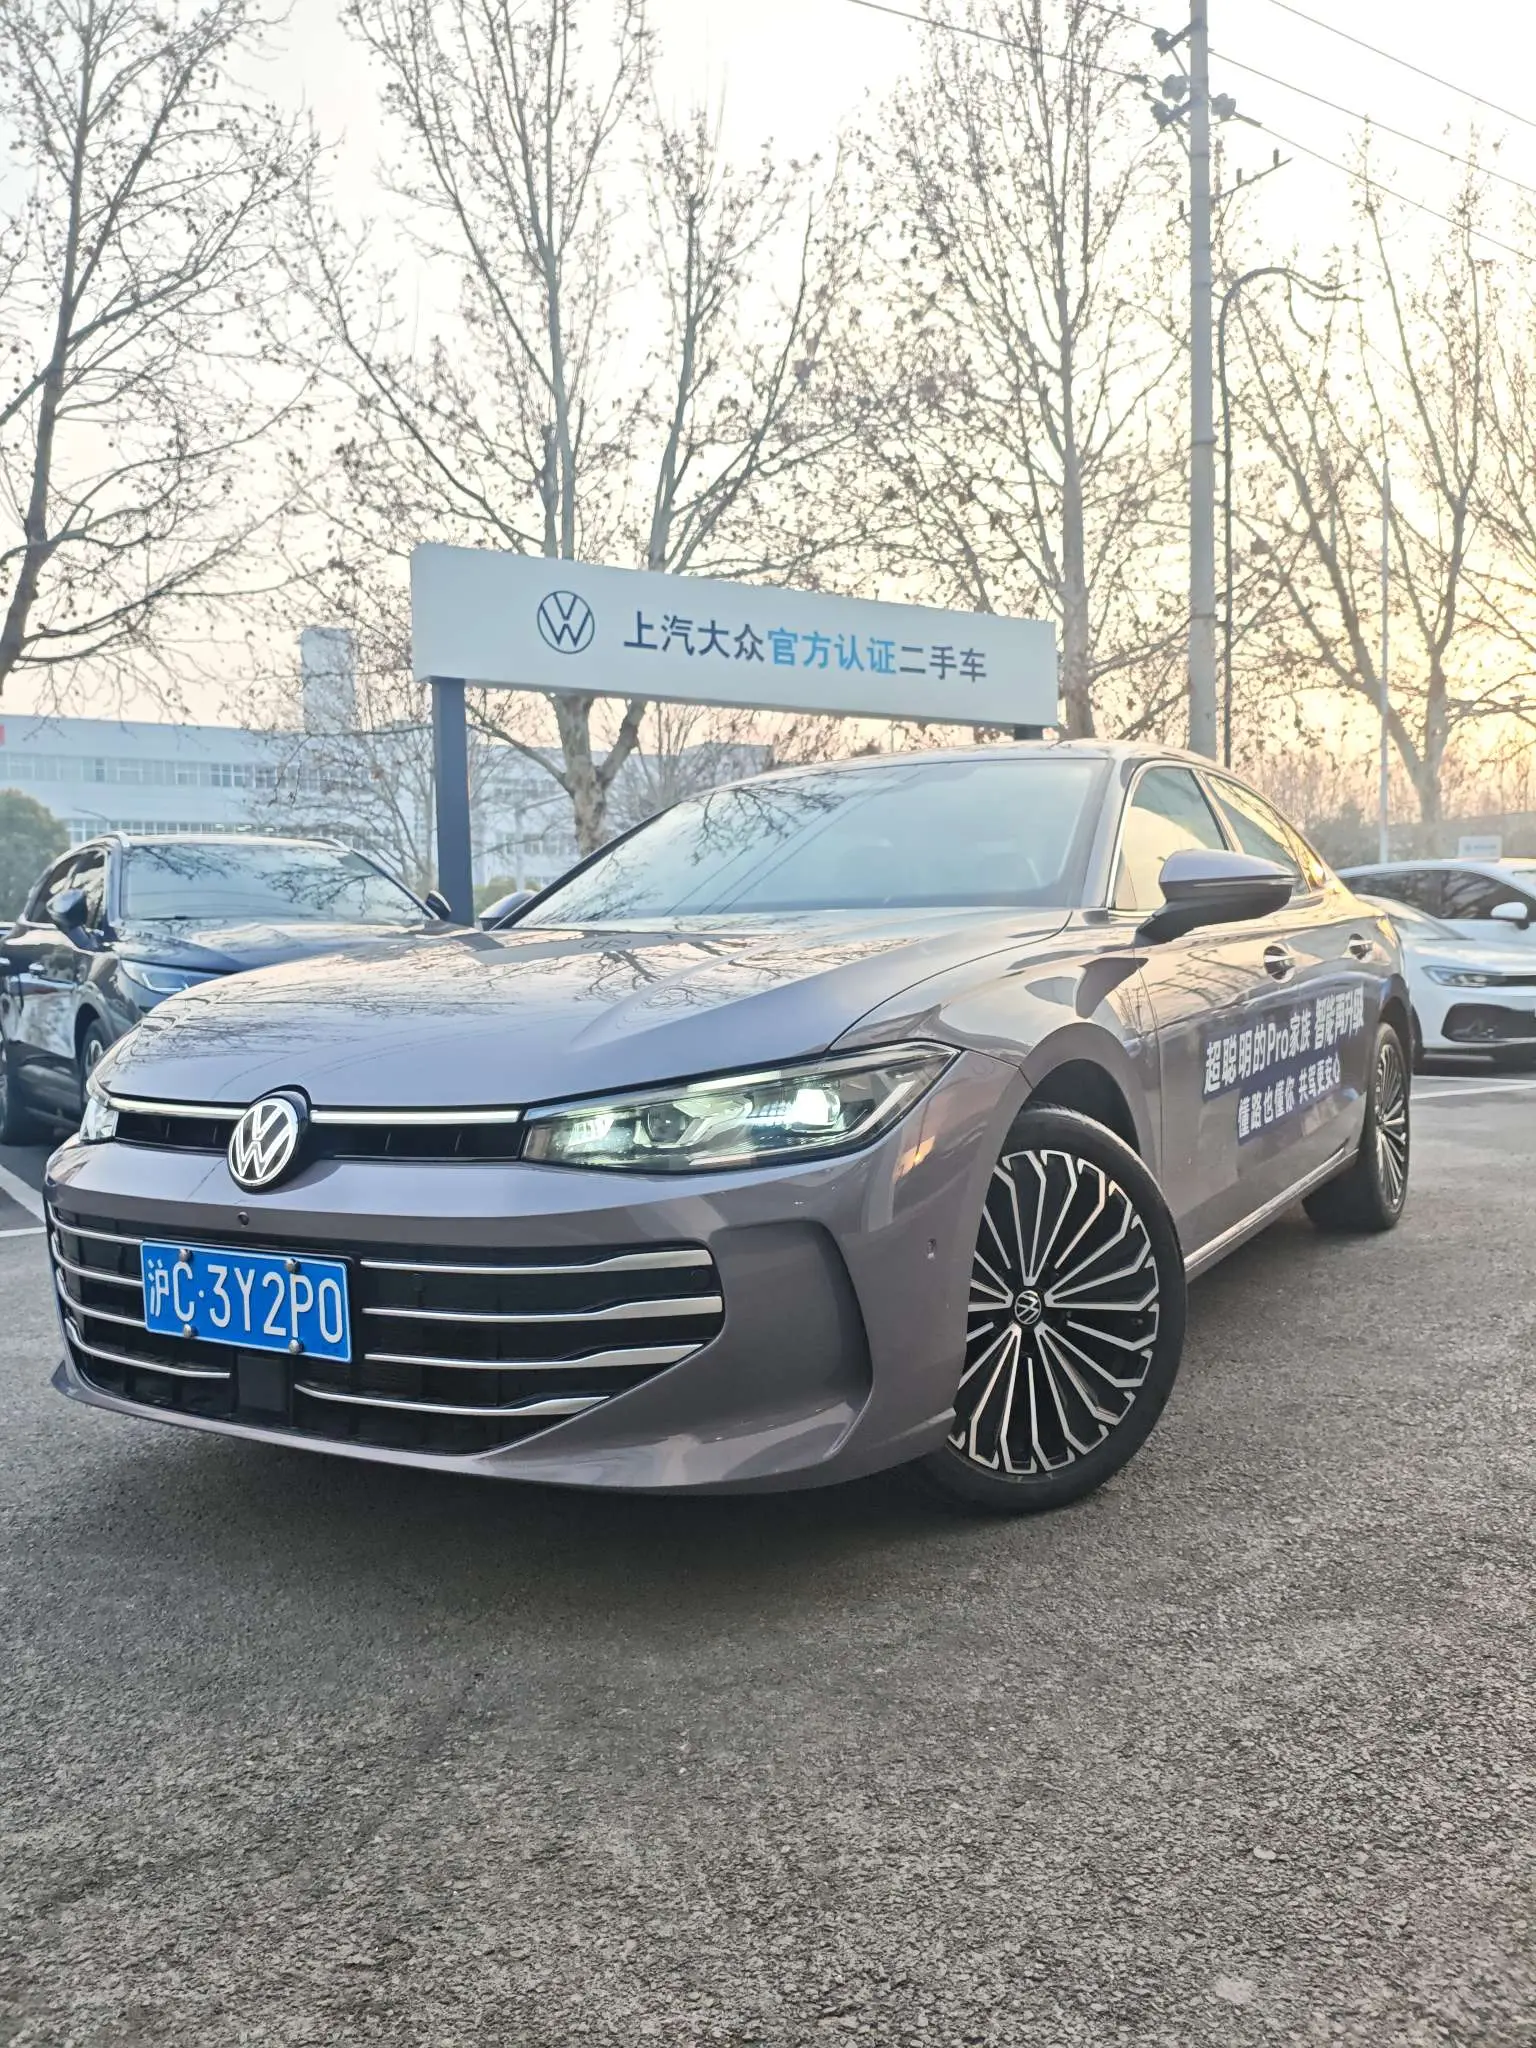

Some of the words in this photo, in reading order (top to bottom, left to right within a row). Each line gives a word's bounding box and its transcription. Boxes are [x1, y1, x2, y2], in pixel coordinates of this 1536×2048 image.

[624, 610, 987, 682] 上汽大众官方认证二手车
[1203, 1007, 1312, 1095] 超聪明的Pro家族
[1314, 984, 1364, 1050] 智能再升级
[1238, 1074, 1295, 1138] 懂路也懂你
